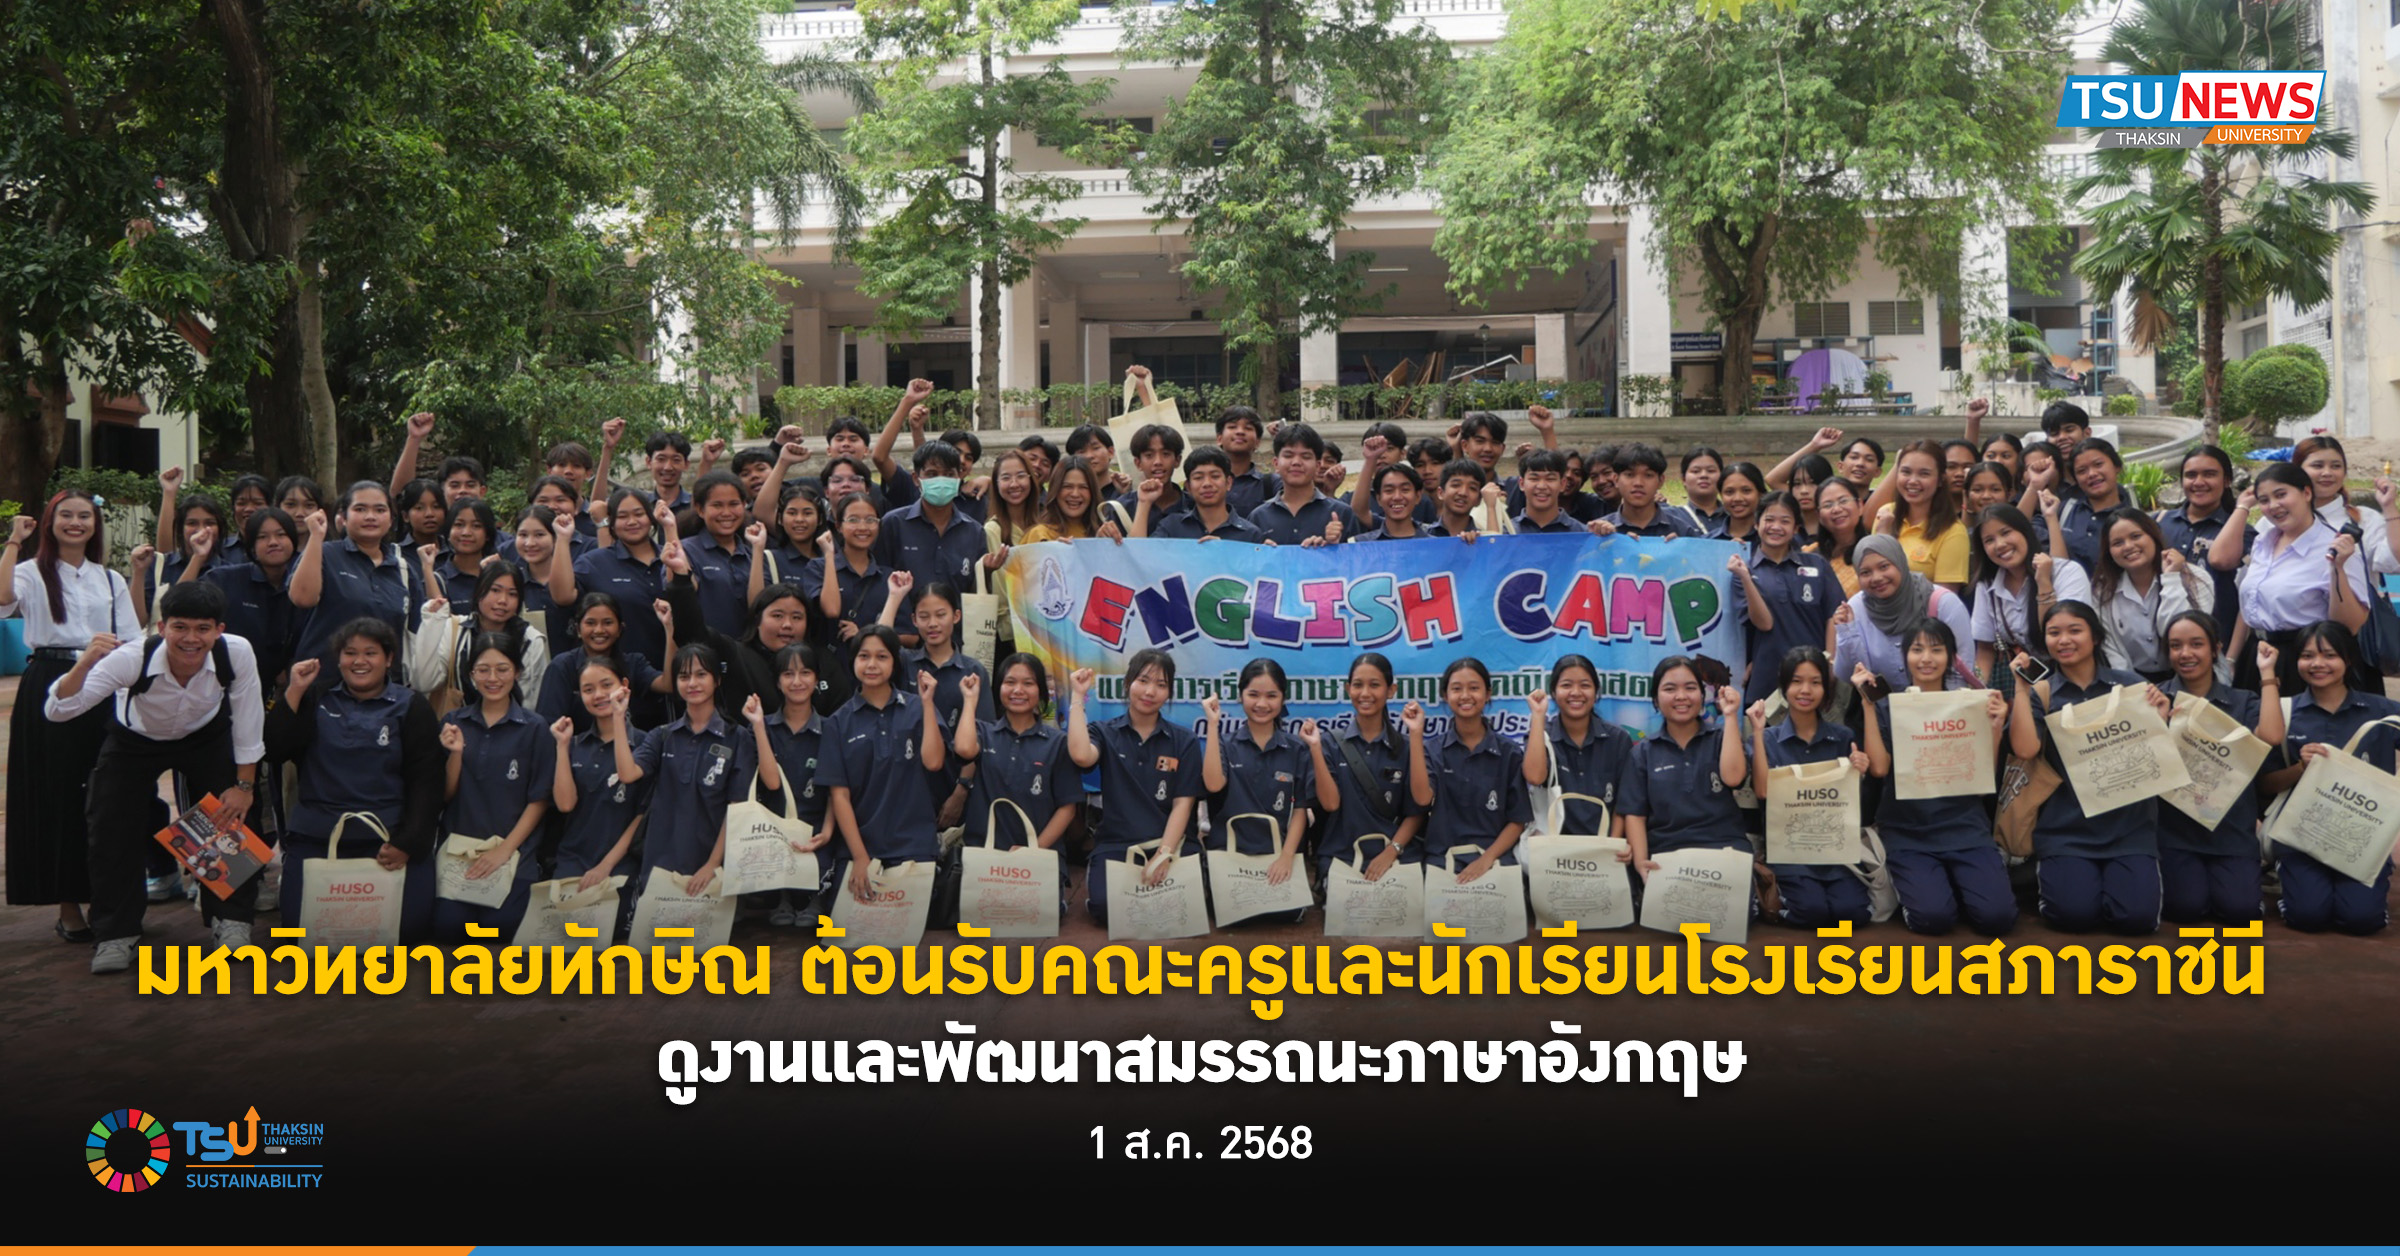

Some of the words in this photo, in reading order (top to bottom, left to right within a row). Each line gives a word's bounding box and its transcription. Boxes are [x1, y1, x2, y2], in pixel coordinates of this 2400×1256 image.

[1078, 572, 1462, 649] ENGLISH
[1496, 569, 1723, 646] CAMP
[1923, 718, 1967, 733] HUSO
[2085, 720, 2132, 744] HUSO
[1940, 730, 1977, 740] UNIVERSITY
[2077, 742, 2108, 757] THAKSIN
[2107, 728, 2148, 747] UNIVERSITY
[2197, 738, 2231, 758] USO
[2197, 745, 2234, 772] UNIVERSITY
[1796, 787, 1839, 800] HUSO
[2330, 782, 2378, 812] HUSO
[1812, 800, 1850, 808] UNIVERSITY
[2314, 786, 2343, 806] THAKSIN
[2343, 801, 2385, 827] UNIVERSITY
[751, 822, 784, 836] HUS
[1556, 857, 1598, 872] HUSO
[990, 865, 1032, 880] HUSO
[1238, 867, 1270, 879] HUS
[1544, 869, 1572, 878] THAKSIN
[1678, 866, 1723, 881] HUSO
[329, 882, 375, 895] HUSO
[1004, 879, 1043, 888] UNIVERSITY
[1665, 875, 1693, 883] THAKSIN
[1693, 879, 1732, 892] UNIVERSITY
[876, 889, 906, 903] USO
